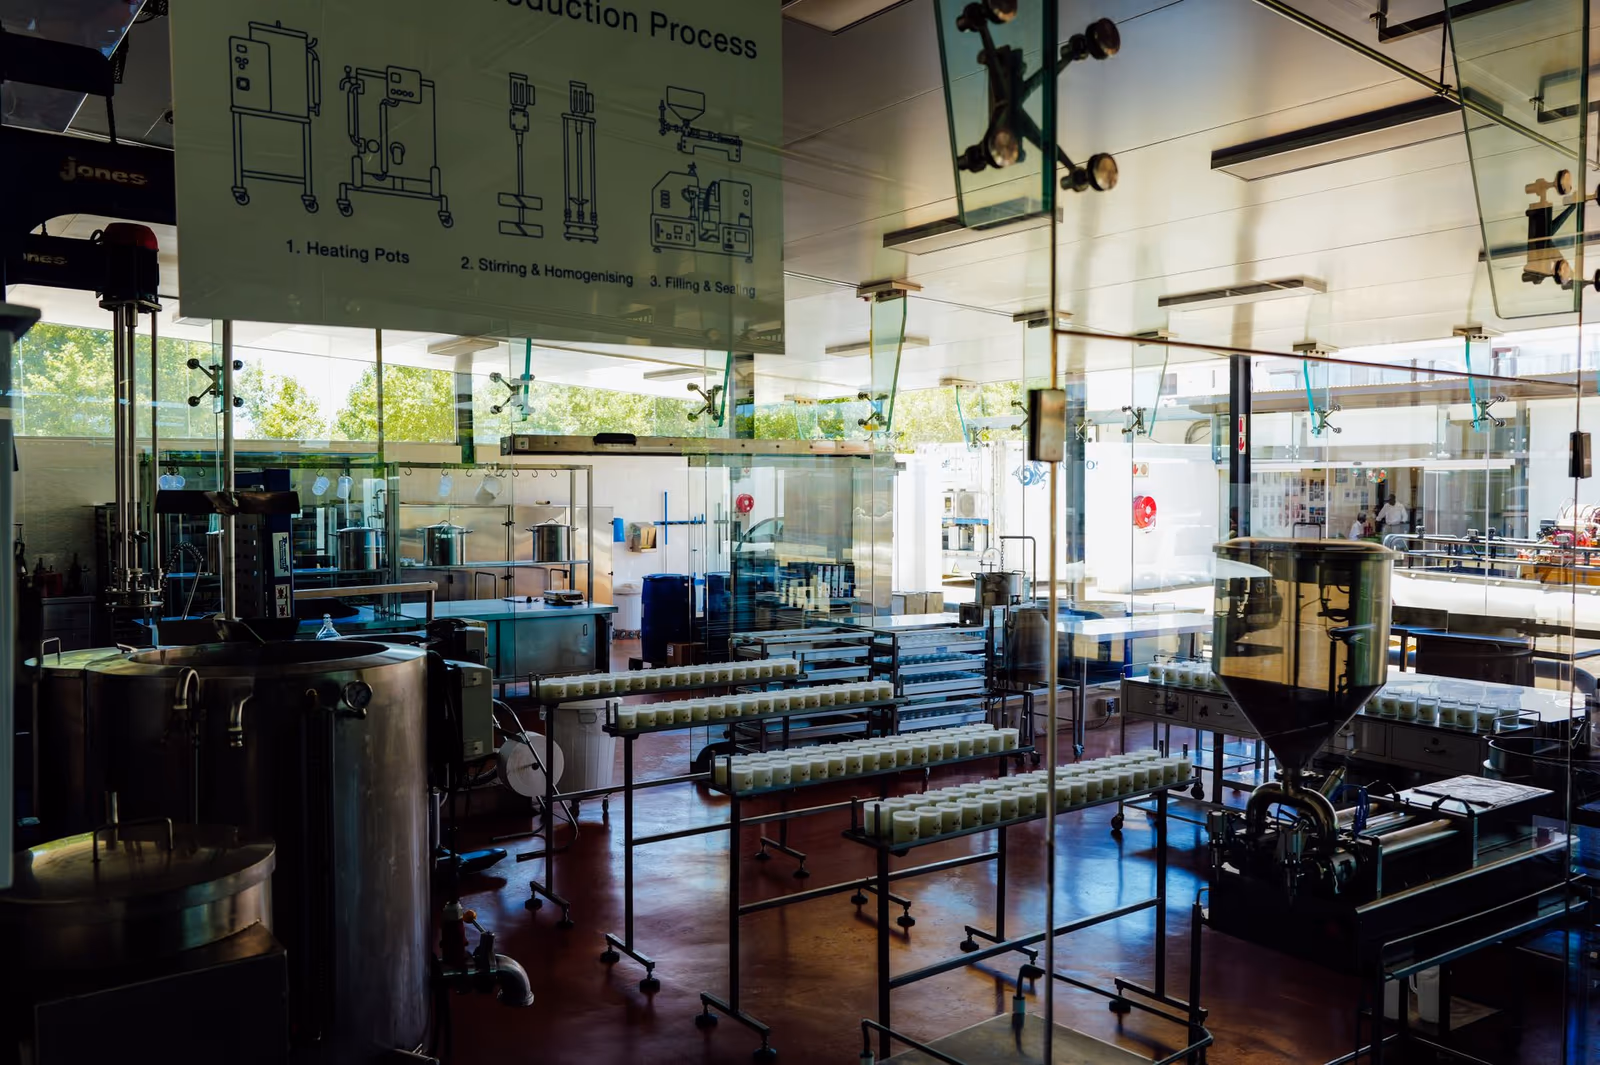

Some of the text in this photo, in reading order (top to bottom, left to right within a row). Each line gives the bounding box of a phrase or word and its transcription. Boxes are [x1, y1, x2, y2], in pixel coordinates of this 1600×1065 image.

[493, 0, 758, 59] uction Process
[59, 156, 148, 185] jones
[286, 239, 410, 264] 1. Heating Pots
[461, 256, 634, 287] 2. Stirring & Homogenising
[650, 275, 661, 288] 3.
[665, 276, 700, 294] Filling
[703, 280, 712, 292] &
